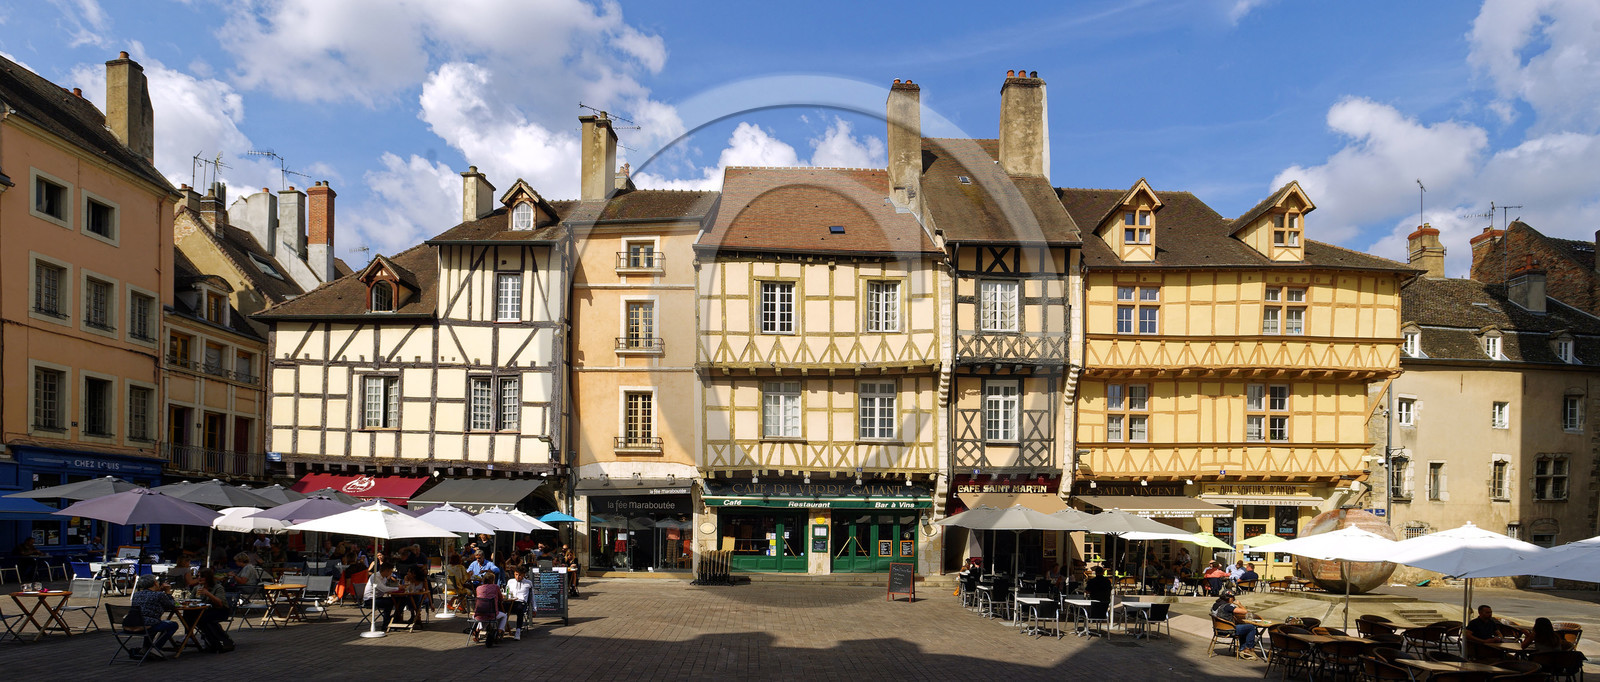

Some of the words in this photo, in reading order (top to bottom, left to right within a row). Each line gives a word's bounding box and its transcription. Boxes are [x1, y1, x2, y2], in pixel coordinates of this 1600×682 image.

[74, 459, 95, 468] CHEZ
[774, 484, 792, 494] DU
[798, 484, 845, 495] VERRE
[850, 485, 903, 495] GALANT
[983, 484, 1011, 493] SAINT
[1012, 485, 1047, 493] MARTIN
[1096, 486, 1127, 496] SAINT
[1133, 486, 1178, 496] VINCENT
[1220, 485, 1233, 495] AUX
[1237, 485, 1266, 495] SAVEURS
[1270, 485, 1297, 495] D'ANTAN
[608, 501, 615, 509] la
[615, 500, 628, 512] fée
[628, 501, 676, 509] maraboutée
[891, 500, 896, 508] à
